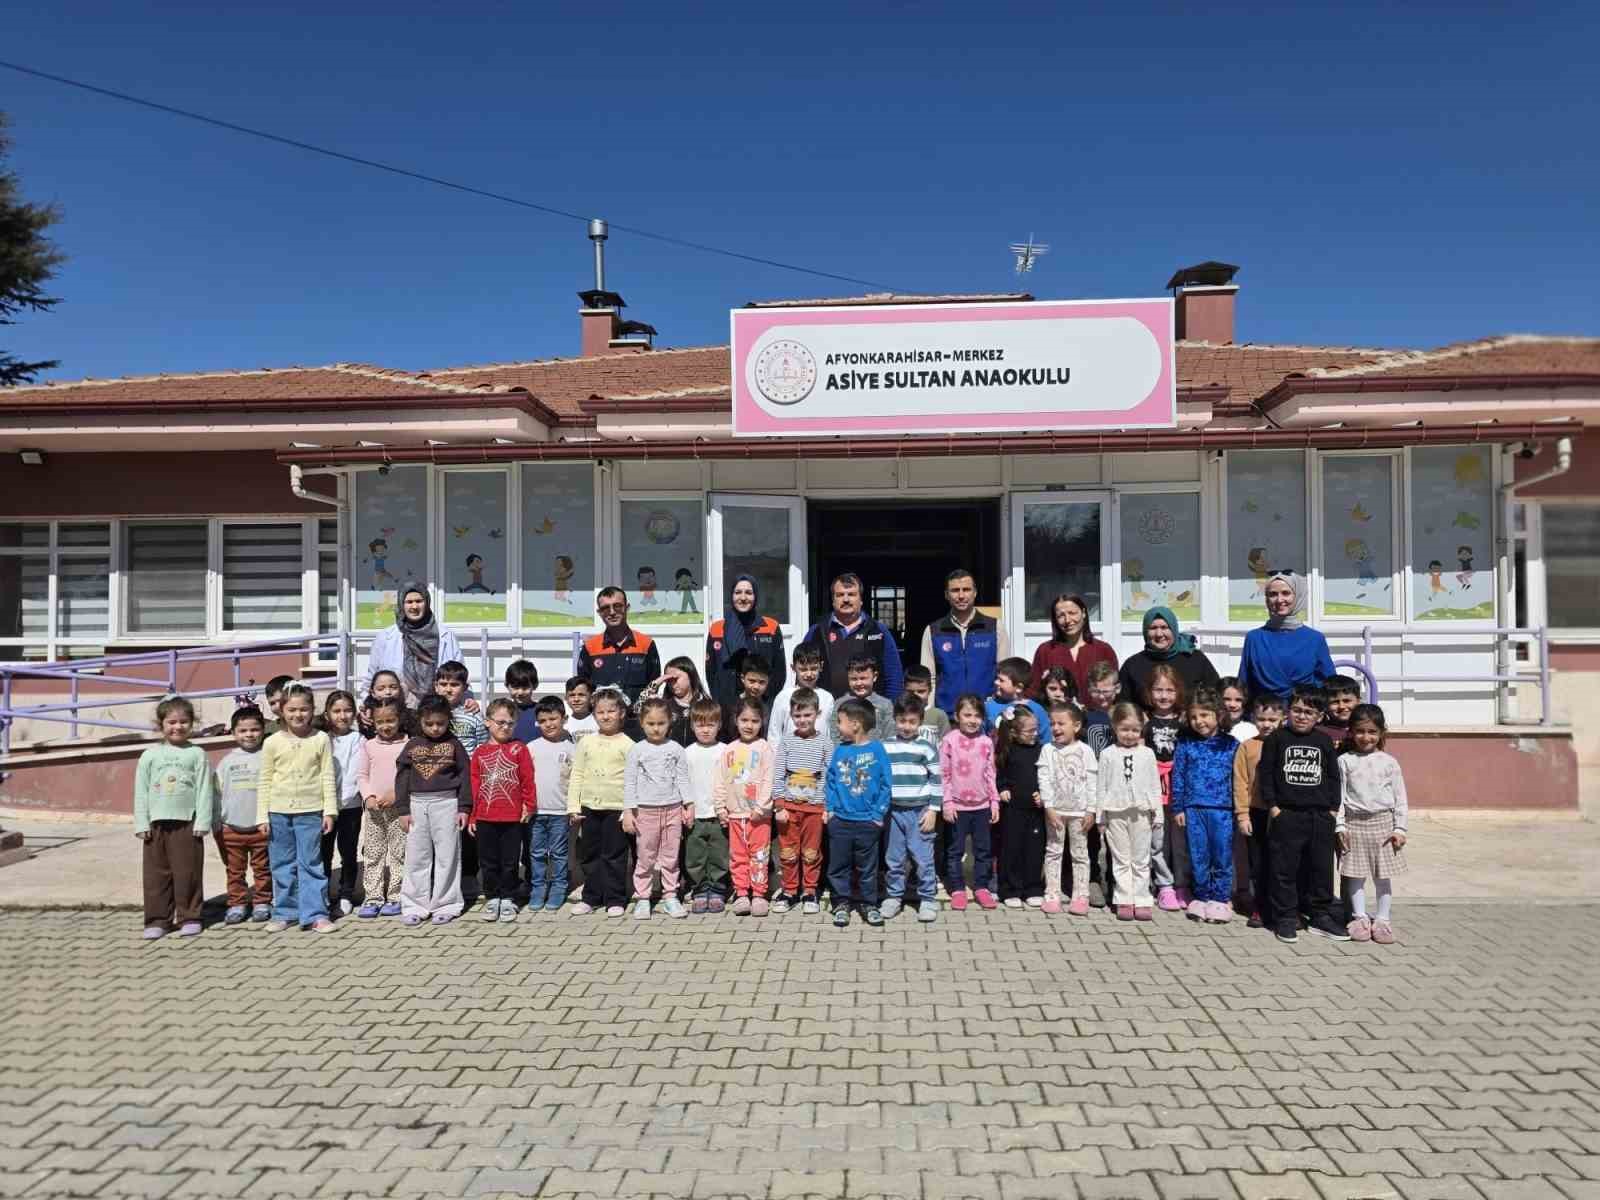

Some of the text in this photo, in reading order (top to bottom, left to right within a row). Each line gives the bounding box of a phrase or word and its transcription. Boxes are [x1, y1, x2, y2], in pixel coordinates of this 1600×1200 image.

[825, 367, 1071, 390] ASİYE SULTAN ANAOKULU
[1293, 749, 1319, 759] PLAY
[1283, 759, 1321, 778] daddy
